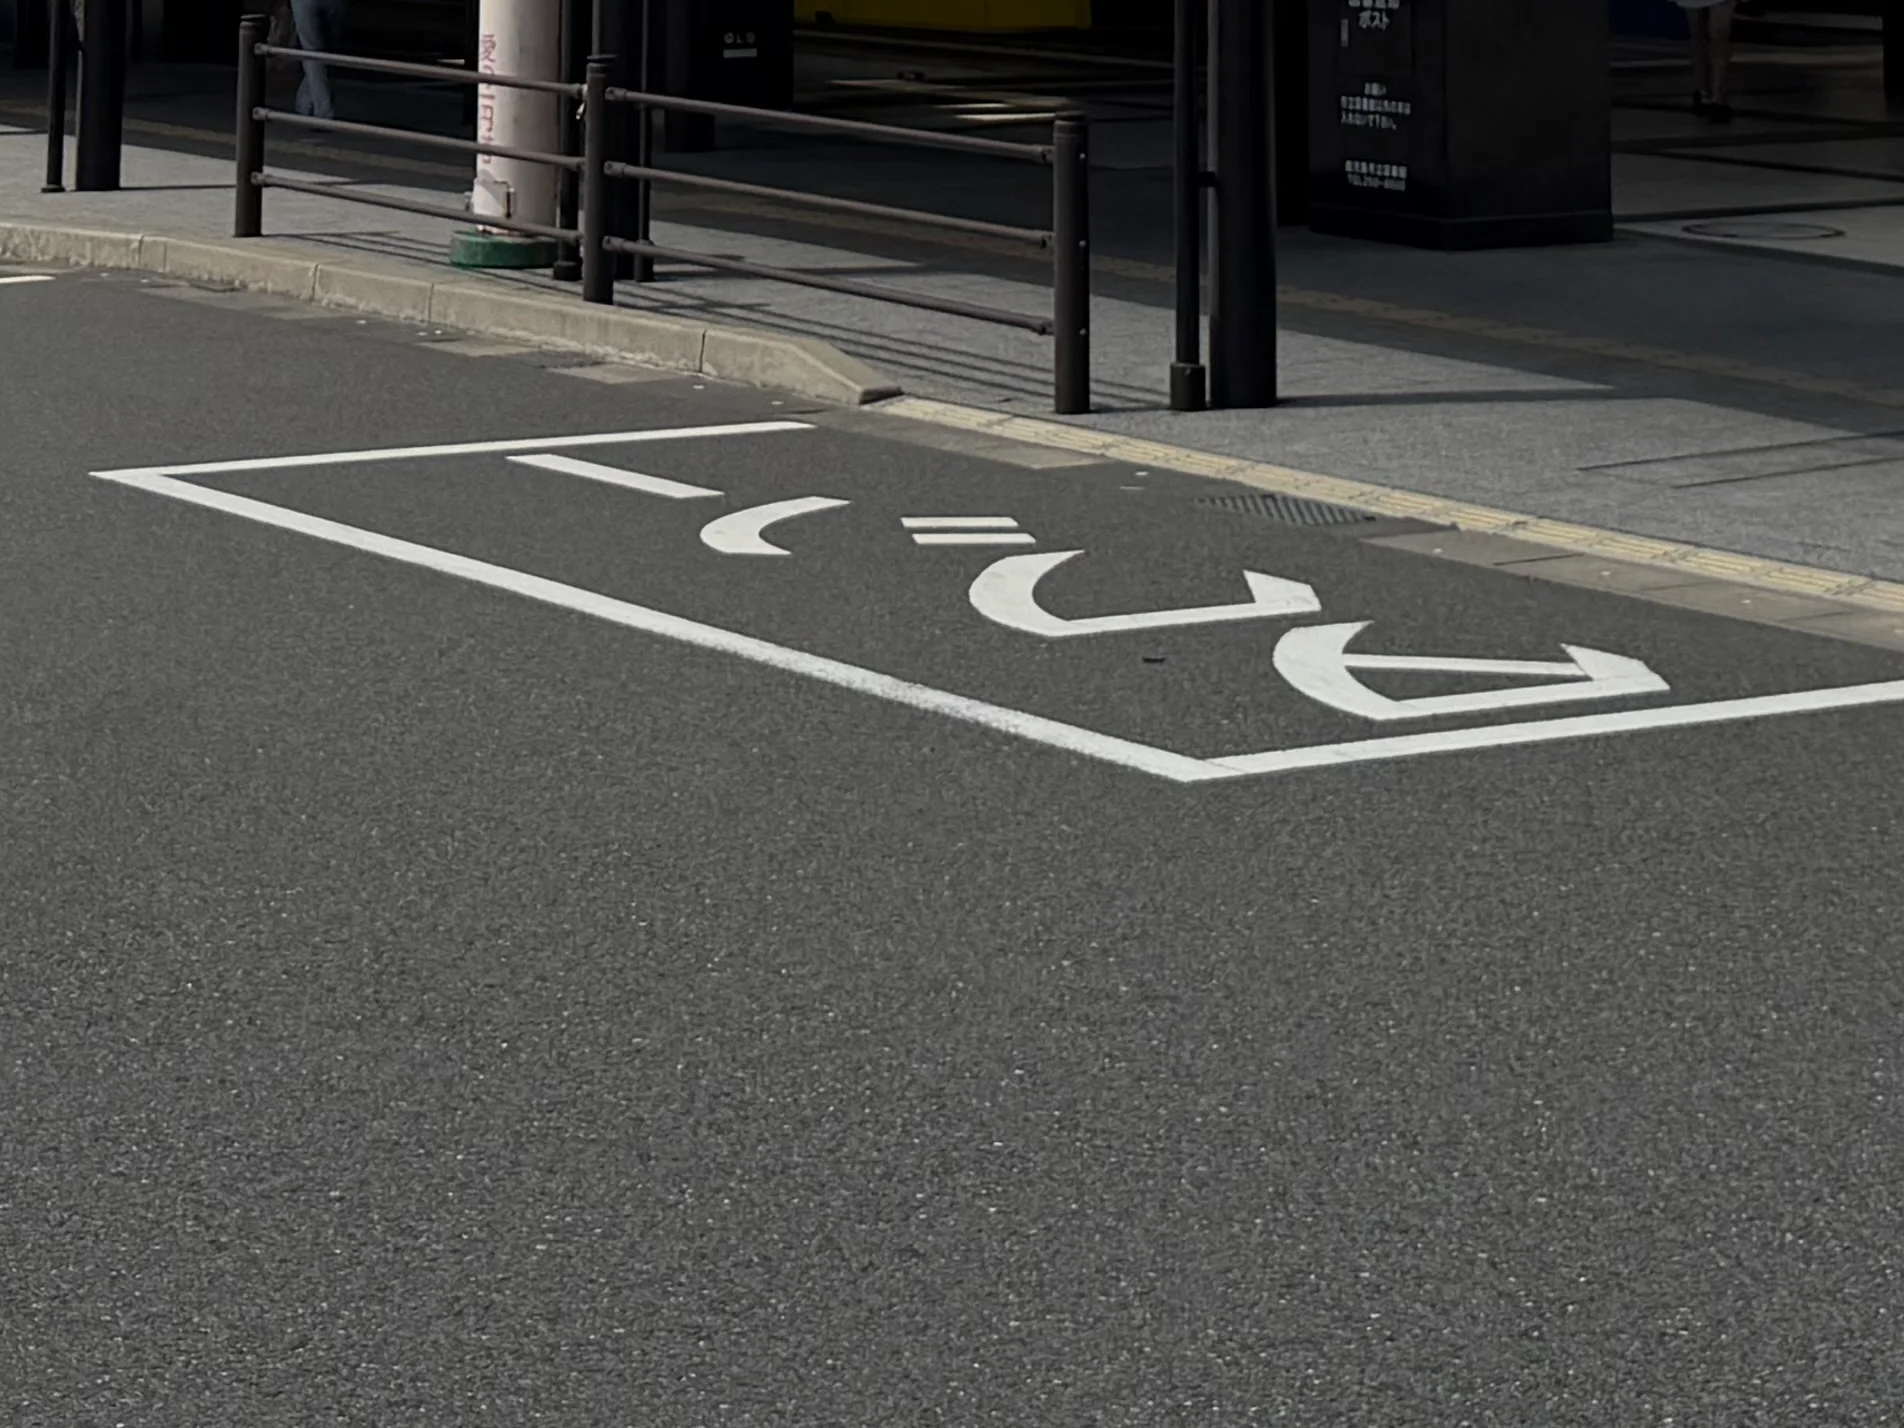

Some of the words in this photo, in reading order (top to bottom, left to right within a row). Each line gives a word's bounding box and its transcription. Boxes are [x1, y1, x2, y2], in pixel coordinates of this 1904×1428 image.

[1358, 10, 1390, 30] ポスト
[505, 453, 1672, 722] タクシー
